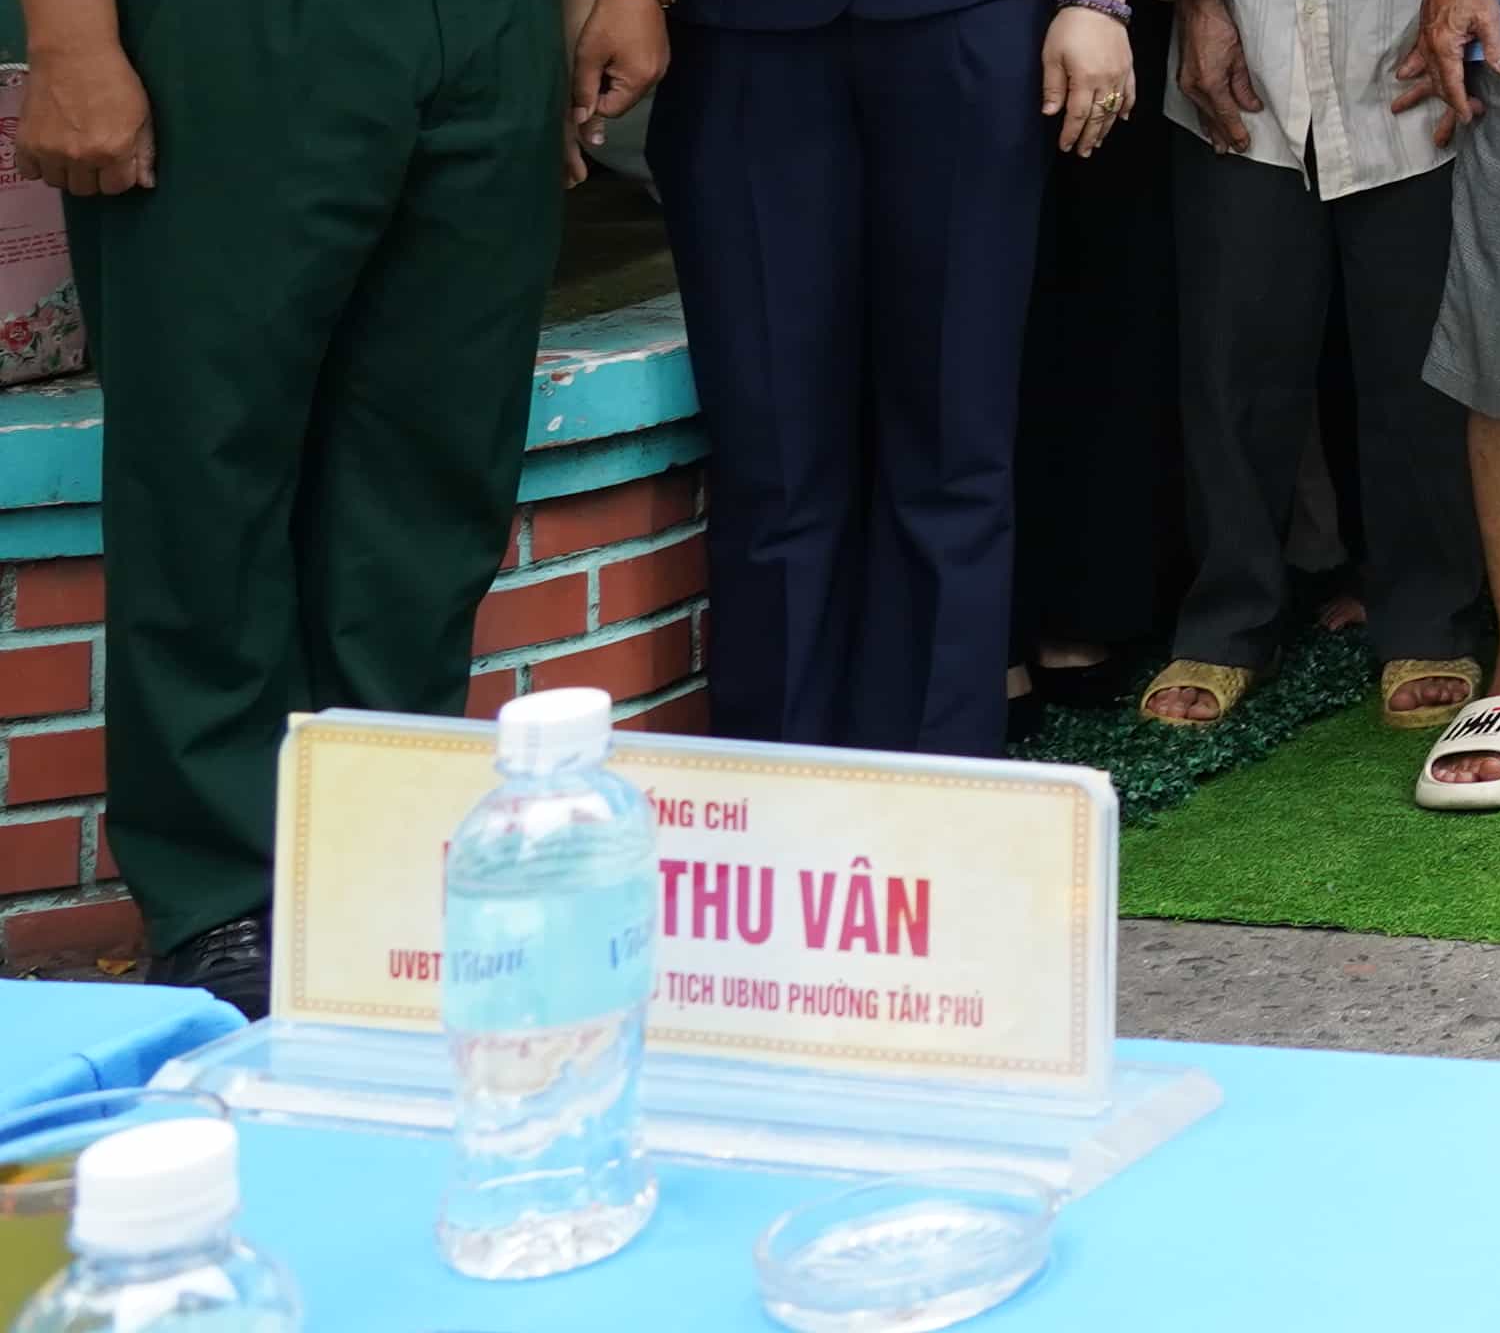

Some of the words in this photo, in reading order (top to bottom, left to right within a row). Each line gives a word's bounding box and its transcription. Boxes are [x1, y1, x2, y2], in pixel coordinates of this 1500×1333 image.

[704, 798, 749, 832] CHÍ
[659, 858, 775, 946] THU
[798, 856, 932, 958] VÂN
[722, 976, 781, 1012] UBND
